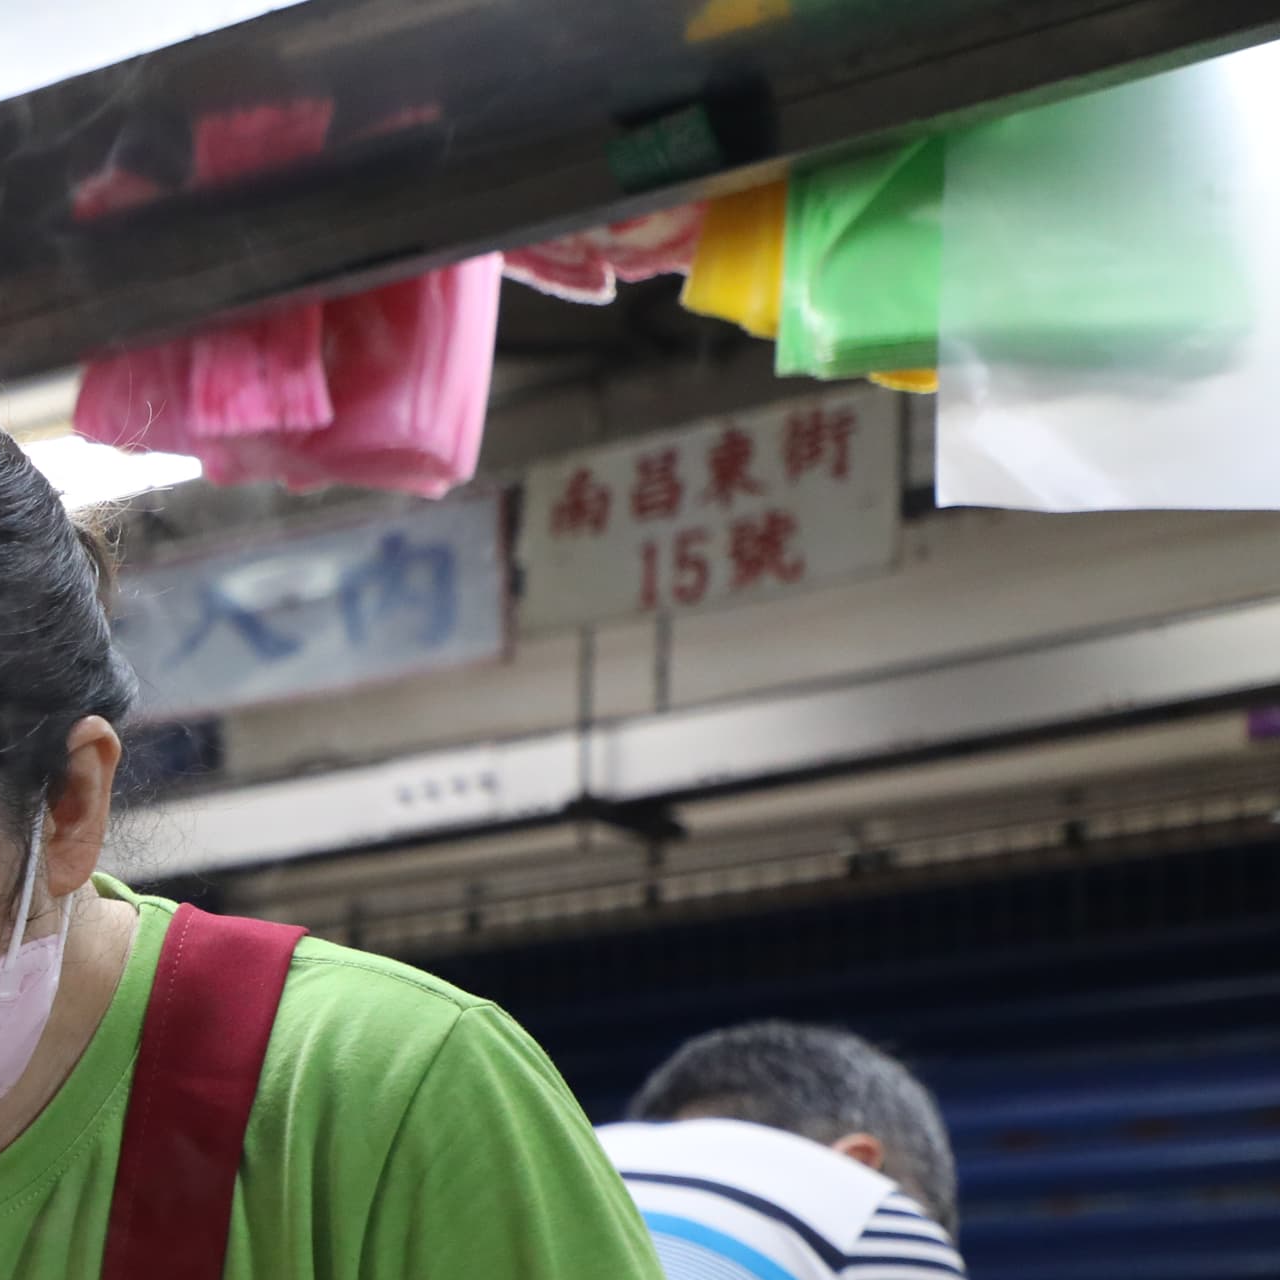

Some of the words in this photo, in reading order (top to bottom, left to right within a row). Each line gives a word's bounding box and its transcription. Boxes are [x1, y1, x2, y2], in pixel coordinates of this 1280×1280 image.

[548, 404, 858, 539] 南昌東街
[640, 508, 807, 610] 15號
